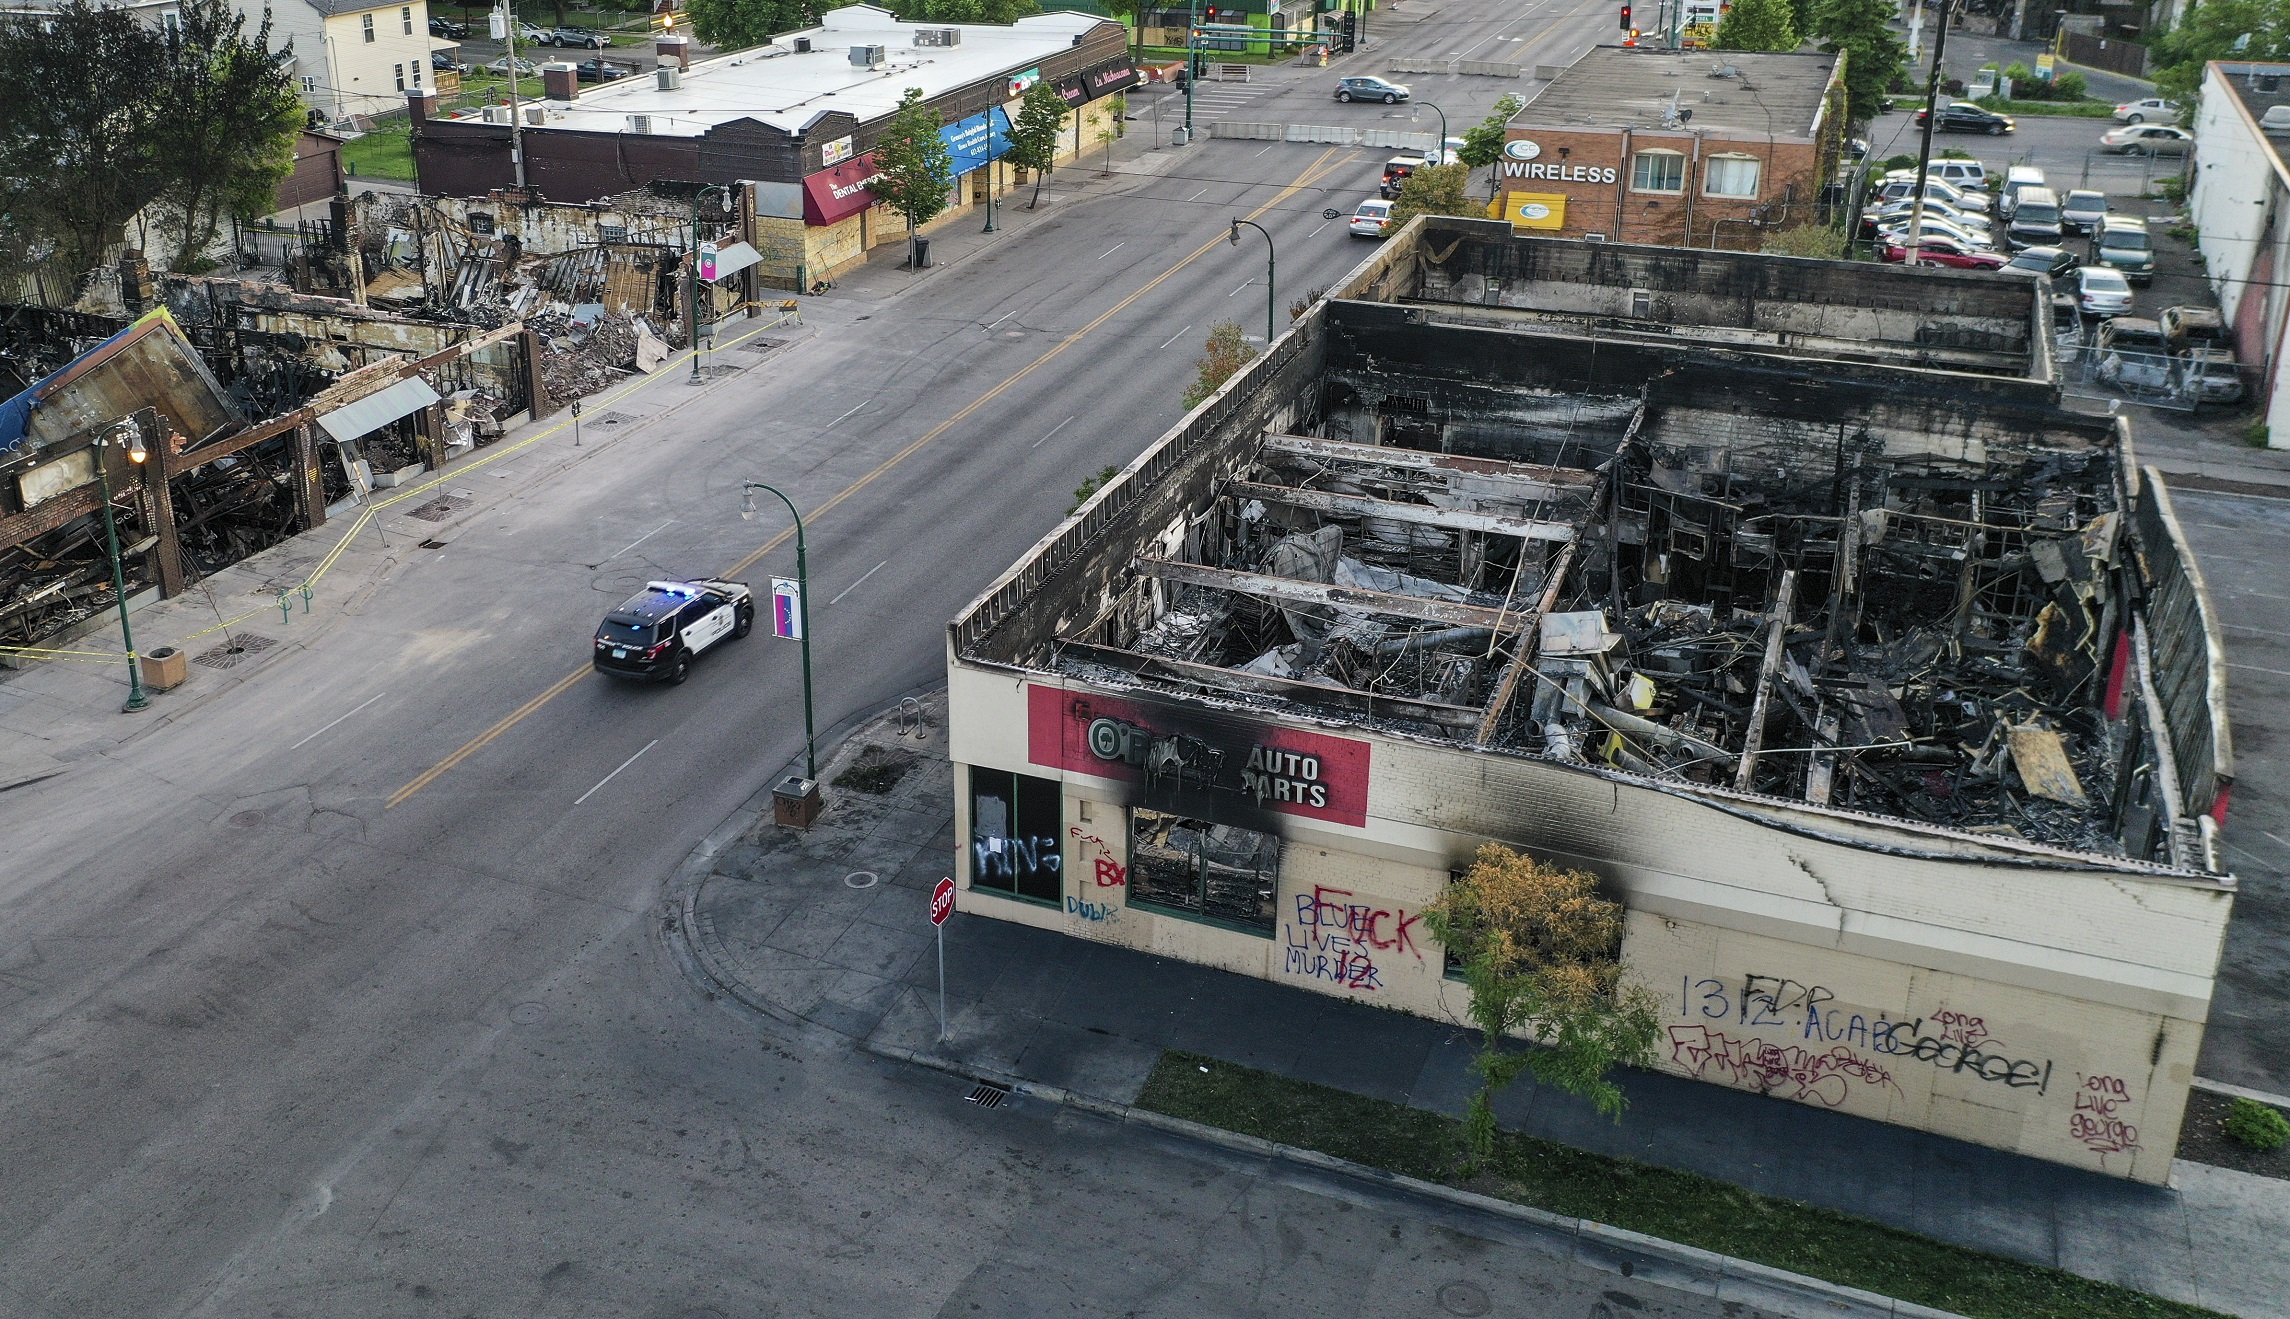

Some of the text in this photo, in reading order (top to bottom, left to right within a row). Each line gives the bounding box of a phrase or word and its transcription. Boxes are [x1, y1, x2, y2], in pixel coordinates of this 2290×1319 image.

[1094, 67, 1131, 88] La Michoacana
[957, 142, 967, 151] Home
[967, 138, 978, 147] Health
[828, 183, 838, 191] The
[1503, 161, 1616, 184] WIRELESS
[832, 185, 859, 200] DENTAL
[711, 621, 731, 636] POLICE
[1246, 745, 1319, 782] AUTO
[932, 886, 953, 918] STOP
[1295, 894, 1373, 933] BLUE
[1313, 884, 1422, 960] FUCK
[1286, 923, 1368, 958] LIVES
[1285, 946, 1384, 990] MURDER
[1338, 949, 1376, 991] 12
